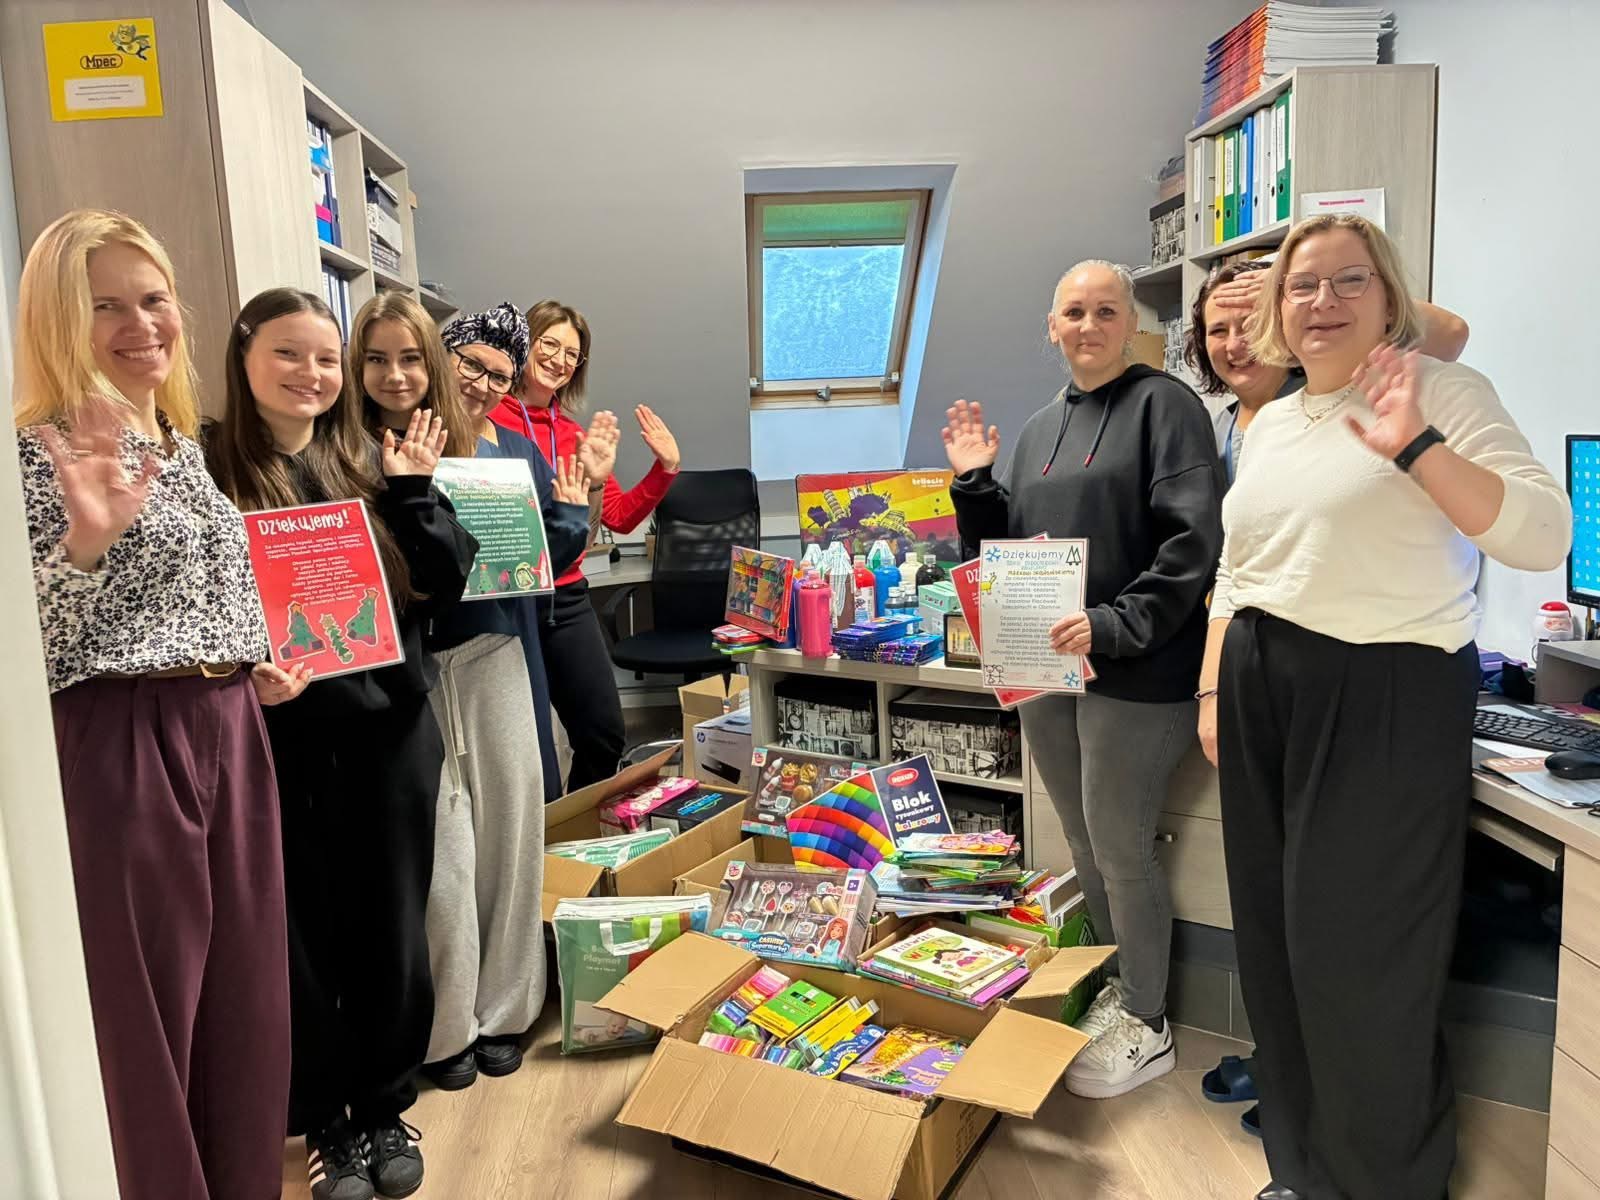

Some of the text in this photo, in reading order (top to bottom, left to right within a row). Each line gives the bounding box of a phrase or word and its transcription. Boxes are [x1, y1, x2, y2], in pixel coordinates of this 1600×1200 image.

[86, 55, 117, 69] Mpec
[1002, 550, 1065, 560] Dziękujemy
[891, 790, 932, 812] Blok
[894, 804, 935, 821] rysunkowy
[894, 813, 941, 832] kolorowy
